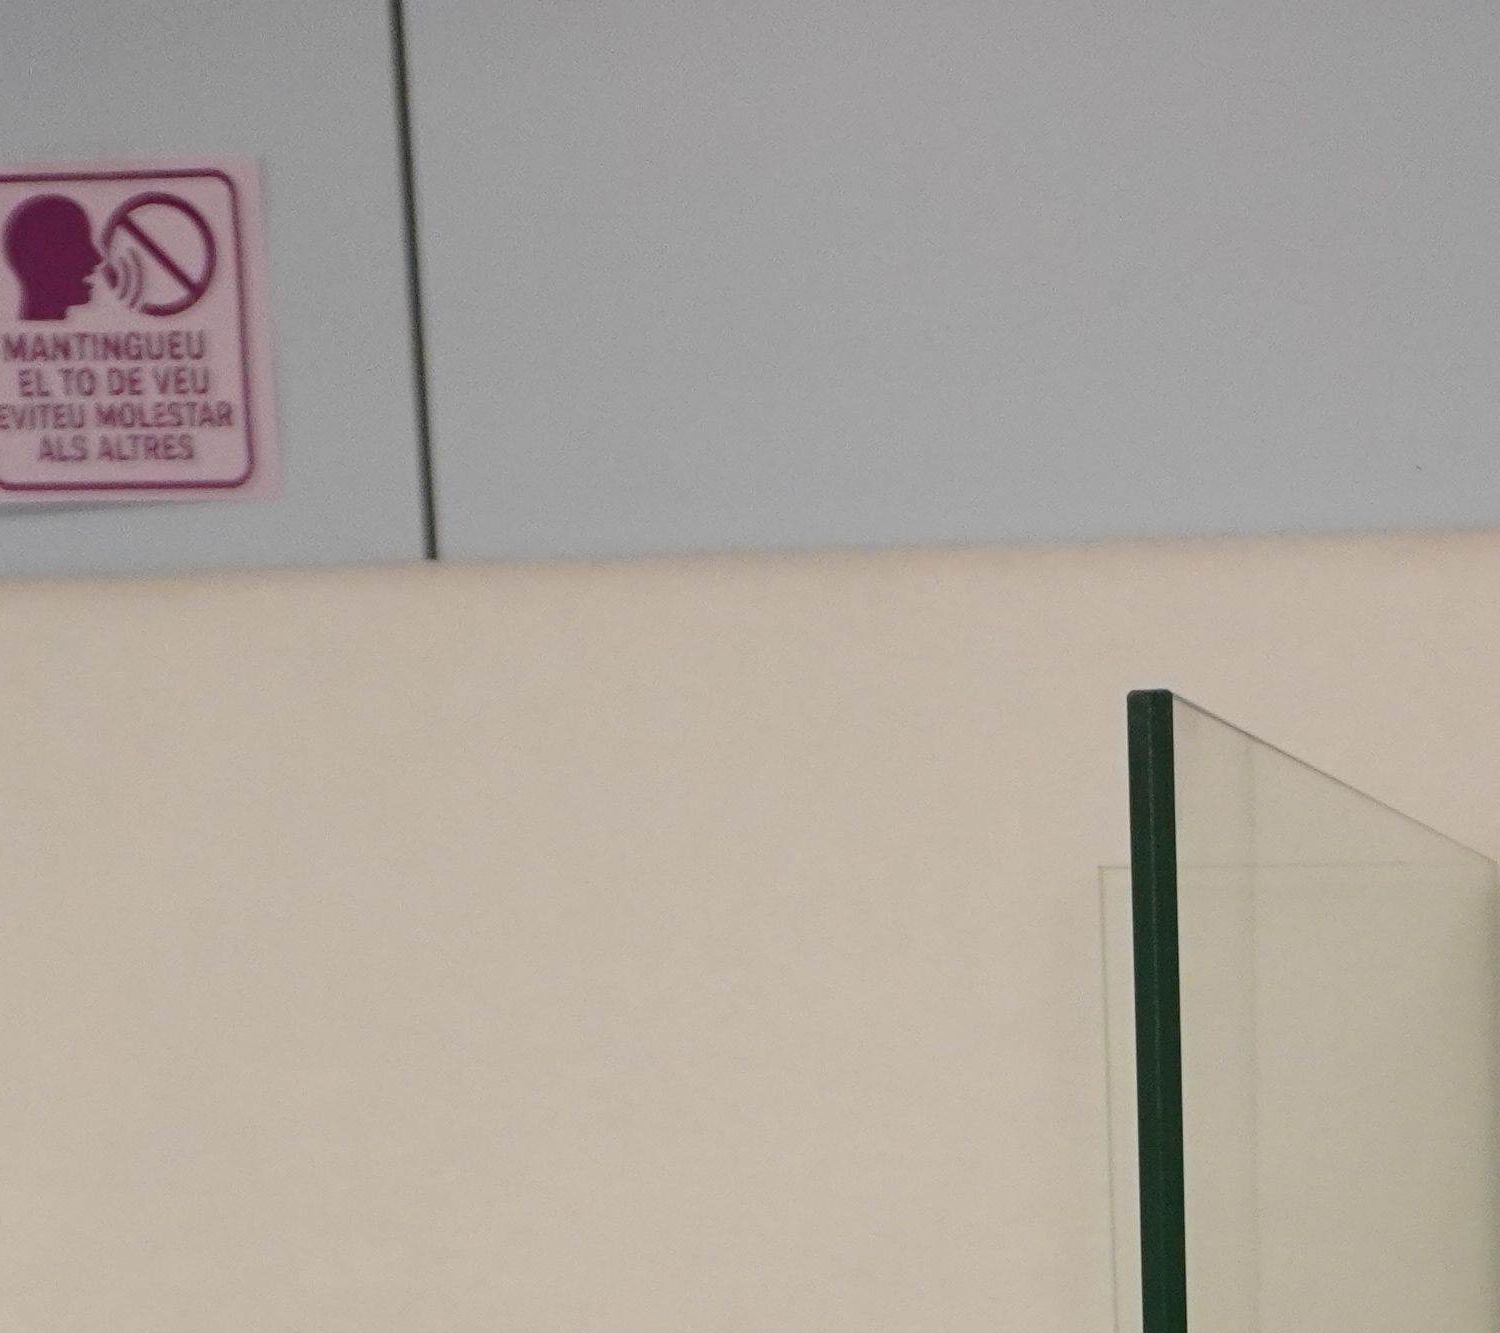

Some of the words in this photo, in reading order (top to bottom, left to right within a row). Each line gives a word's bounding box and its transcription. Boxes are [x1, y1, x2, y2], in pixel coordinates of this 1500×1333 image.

[1, 331, 206, 361] MANTINGUEU
[18, 367, 51, 396] EL
[60, 367, 97, 396] TO
[107, 366, 142, 396] DE
[153, 365, 211, 395] VEU
[95, 401, 234, 429] MOLESTAR
[38, 434, 88, 462] ALS
[98, 433, 195, 461] ALTRES
